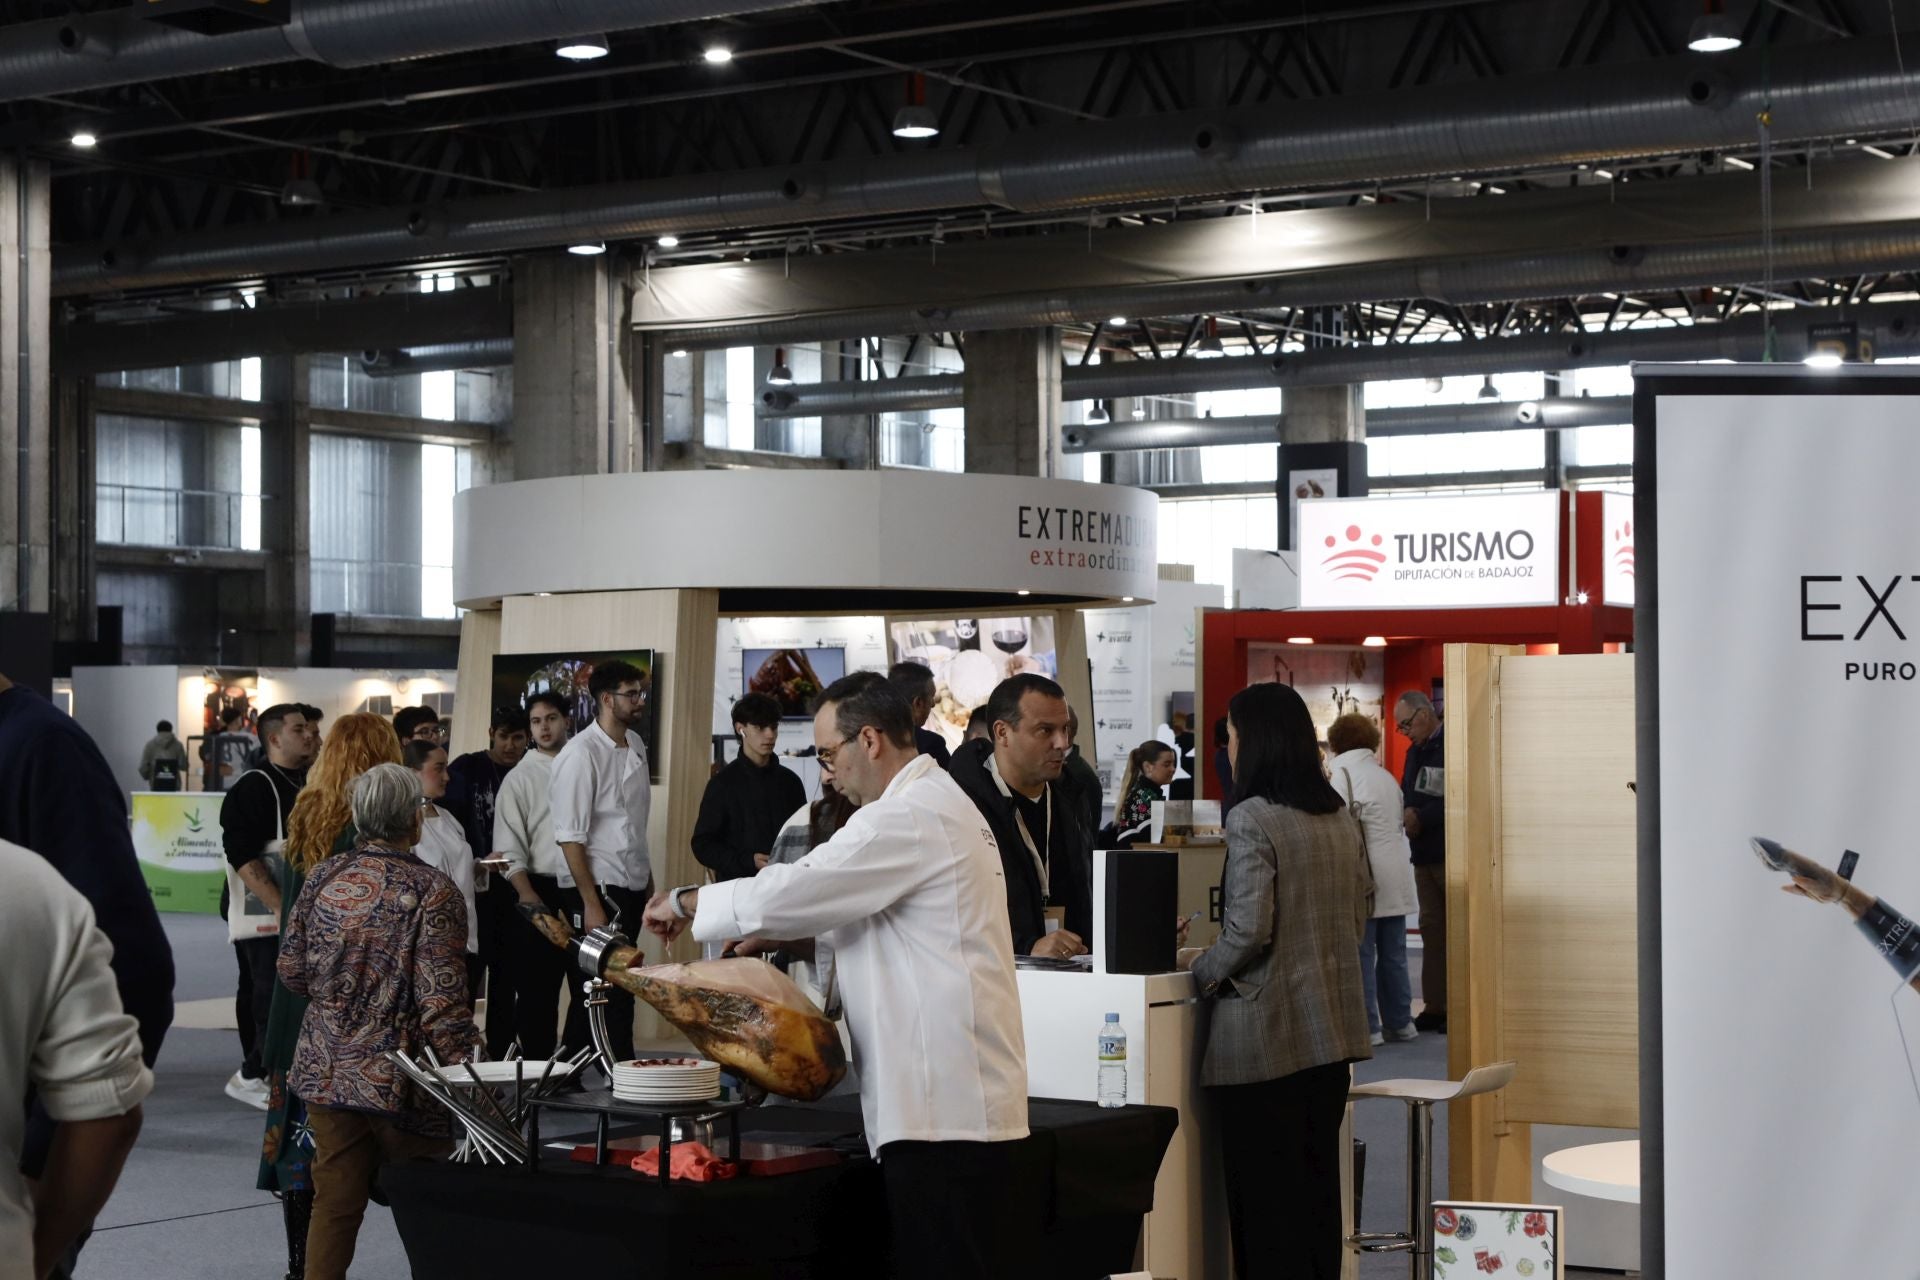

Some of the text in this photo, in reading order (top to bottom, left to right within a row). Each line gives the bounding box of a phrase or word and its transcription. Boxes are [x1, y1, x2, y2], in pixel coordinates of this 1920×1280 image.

[1018, 506, 1152, 547] EXTREMADUR
[1394, 530, 1534, 563] TURISMO
[1394, 565, 1462, 580] DIPUTACIÓN
[1478, 566, 1534, 578] BADAJOZ
[1801, 575, 1920, 641] EX
[1845, 662, 1917, 681] PURO
[1109, 722, 1132, 730] avante
